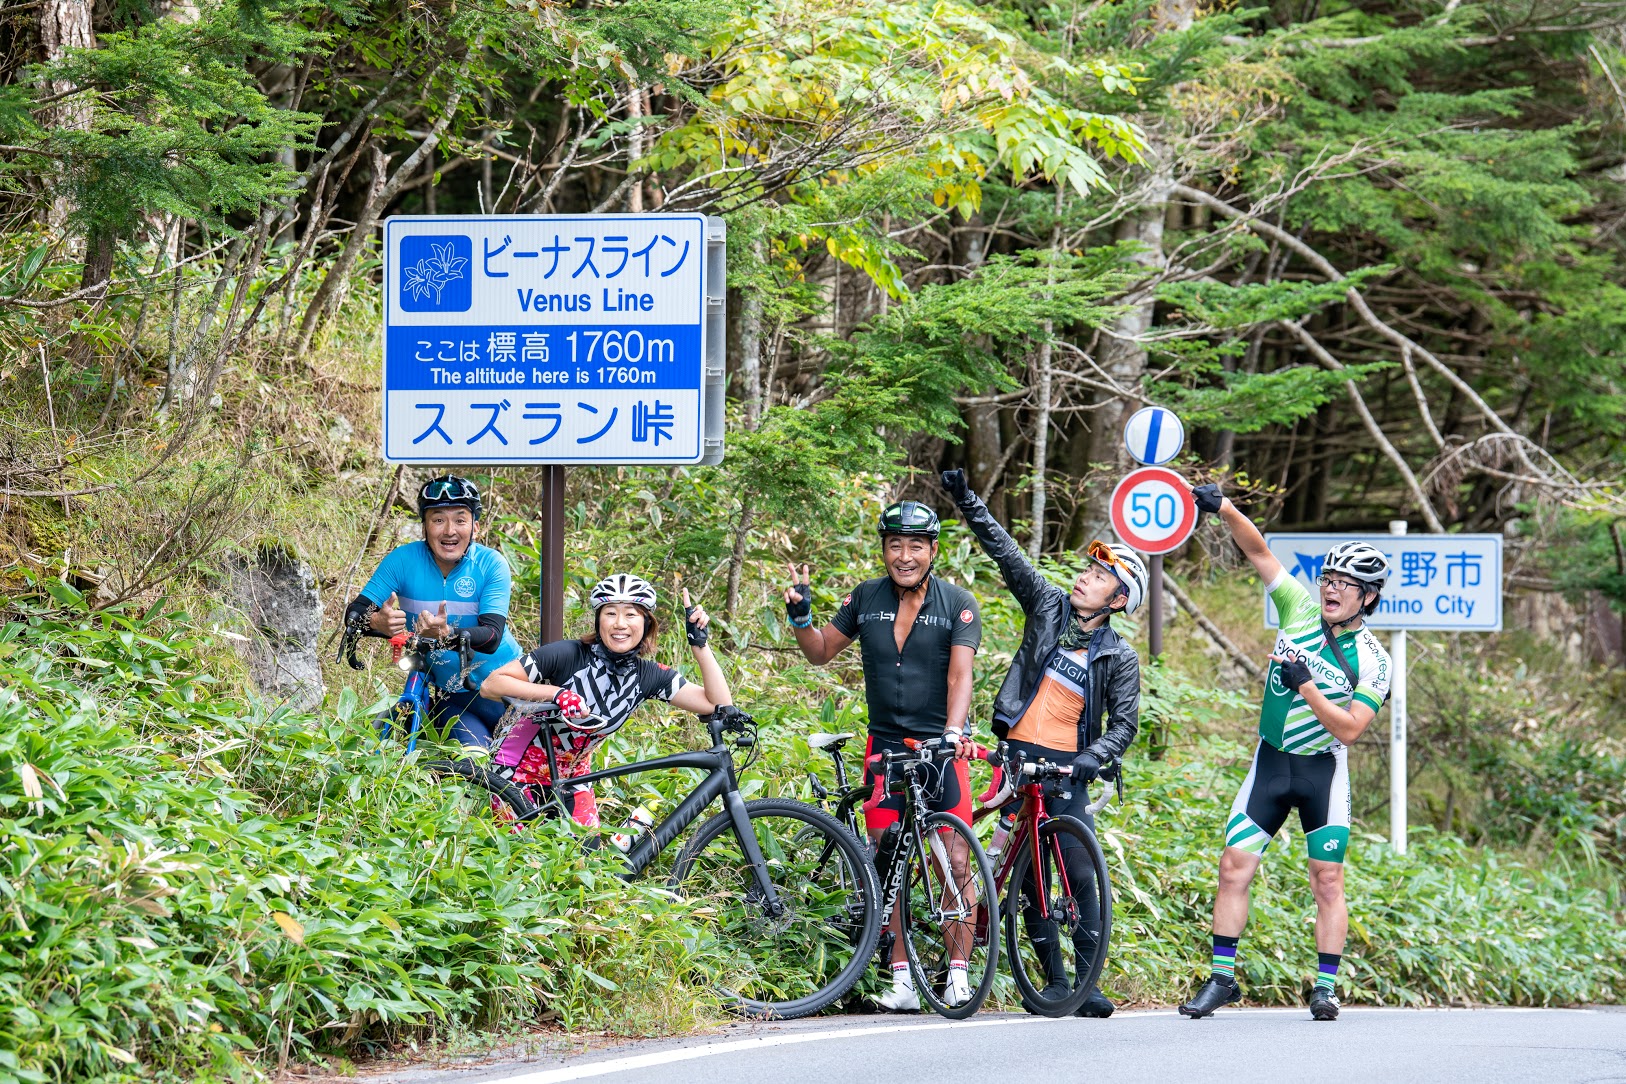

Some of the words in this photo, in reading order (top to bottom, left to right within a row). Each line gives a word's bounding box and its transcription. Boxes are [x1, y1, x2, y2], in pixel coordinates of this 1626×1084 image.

[484, 235, 690, 279] ビーナスライン
[517, 288, 592, 312] Venus
[602, 287, 655, 312] Line
[566, 330, 674, 362] 1760m
[430, 367, 462, 384] The
[465, 367, 526, 384] altitude
[532, 367, 570, 384] here
[576, 367, 590, 384] is
[596, 366, 656, 384] 1760m
[411, 399, 675, 446] スズラン峠
[1131, 492, 1177, 529] 50
[1384, 551, 1484, 588] 野市
[1376, 594, 1424, 615] hino
[1434, 594, 1475, 618] City
